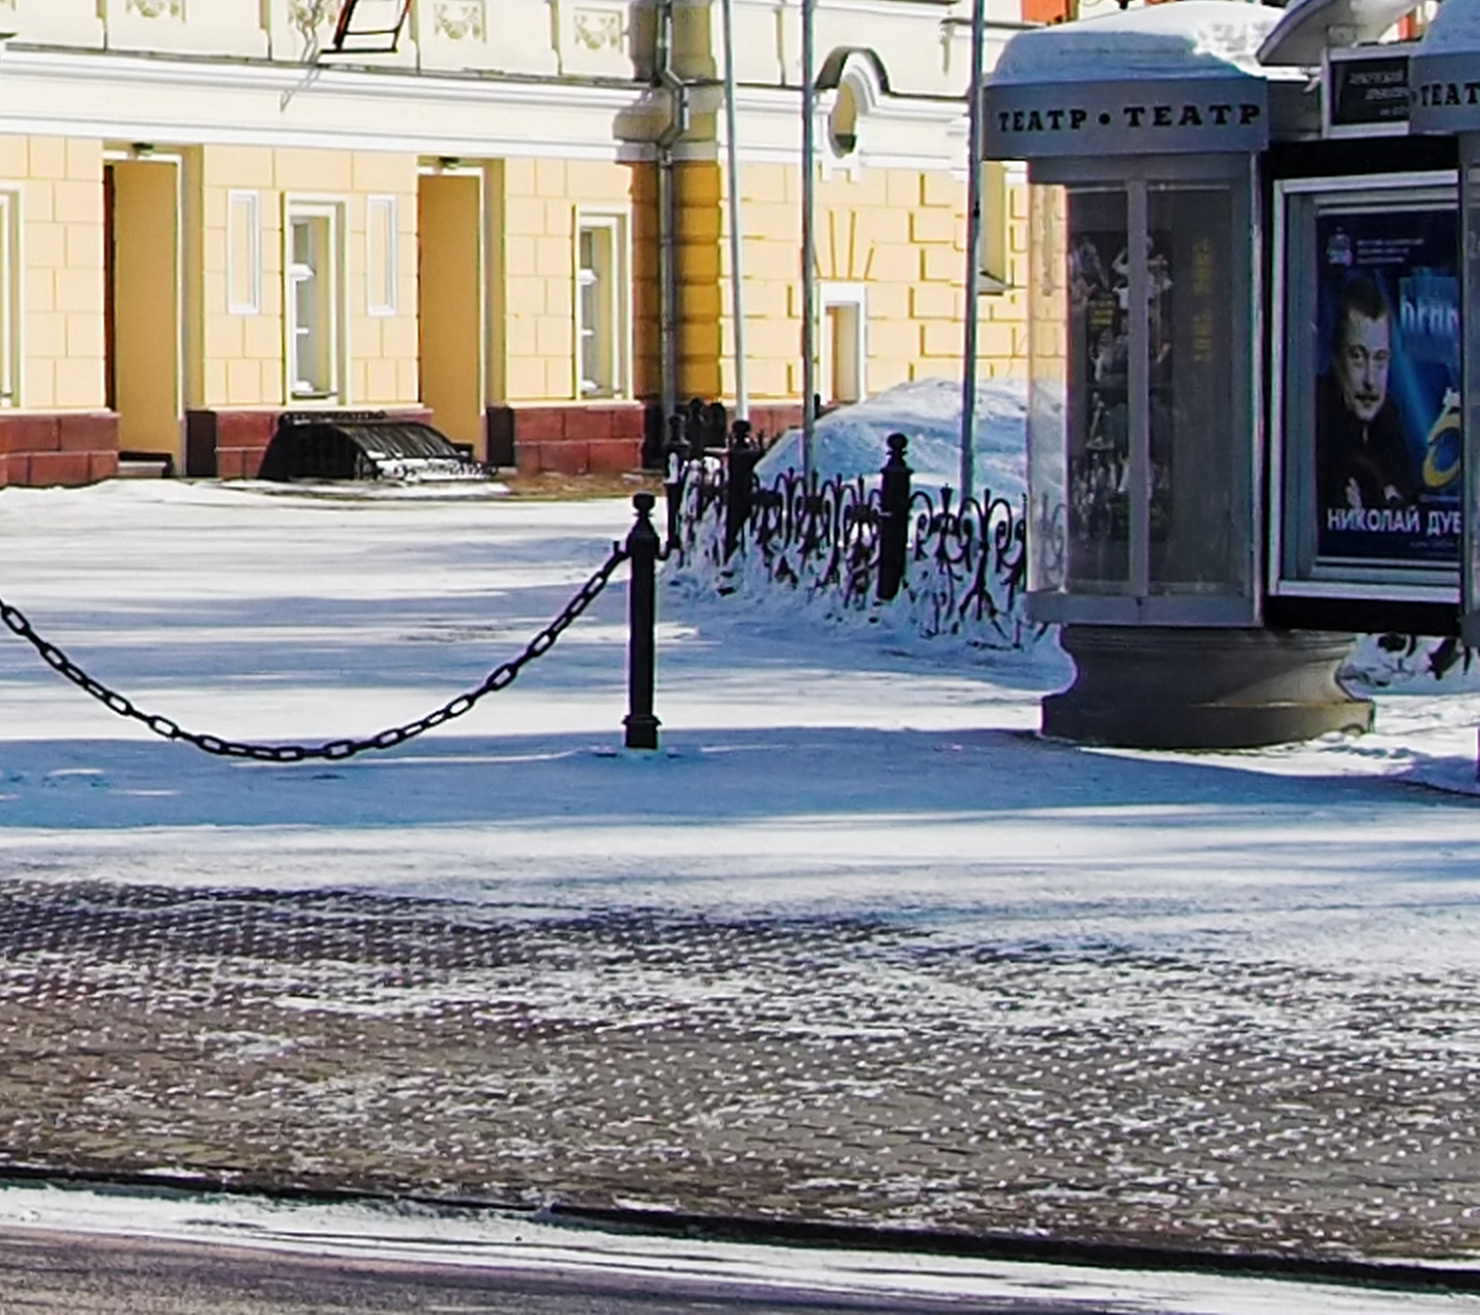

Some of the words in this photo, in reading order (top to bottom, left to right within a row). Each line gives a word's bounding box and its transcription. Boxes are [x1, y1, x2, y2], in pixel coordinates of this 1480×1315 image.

[998, 109, 1088, 132] ТЕАТР
[1123, 104, 1261, 127] ТЕАТР
[1327, 504, 1421, 533] НИКОЛАЙ
